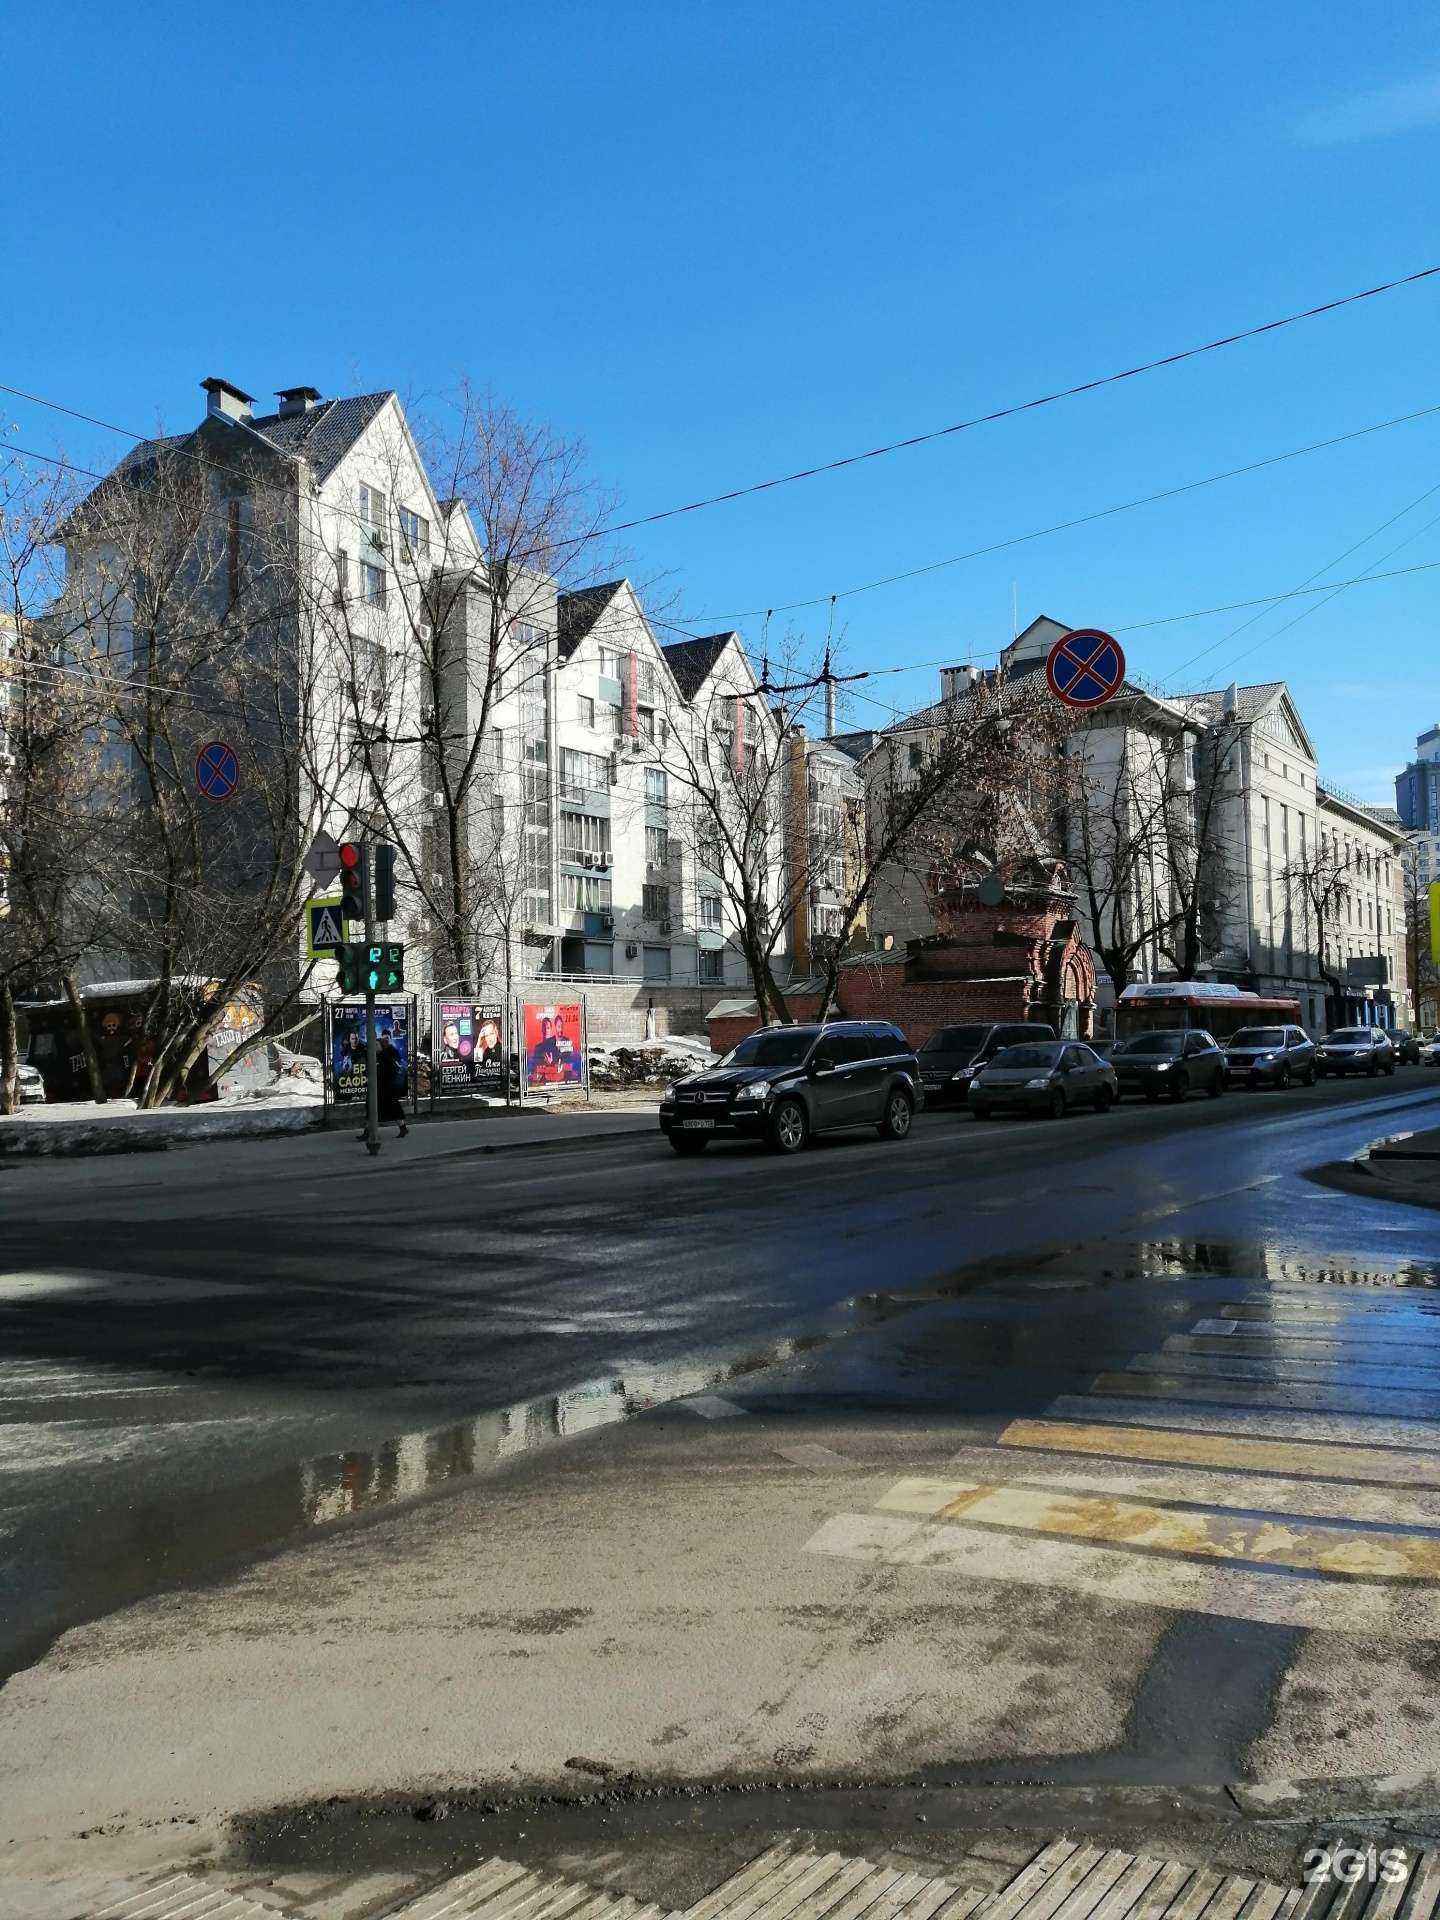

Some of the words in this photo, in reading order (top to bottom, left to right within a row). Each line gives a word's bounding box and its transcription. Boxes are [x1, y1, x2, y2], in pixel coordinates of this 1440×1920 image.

[335, 1008, 344, 1019] 27
[475, 1006, 483, 1020] 7
[442, 1073, 471, 1083] ПЕНКИН
